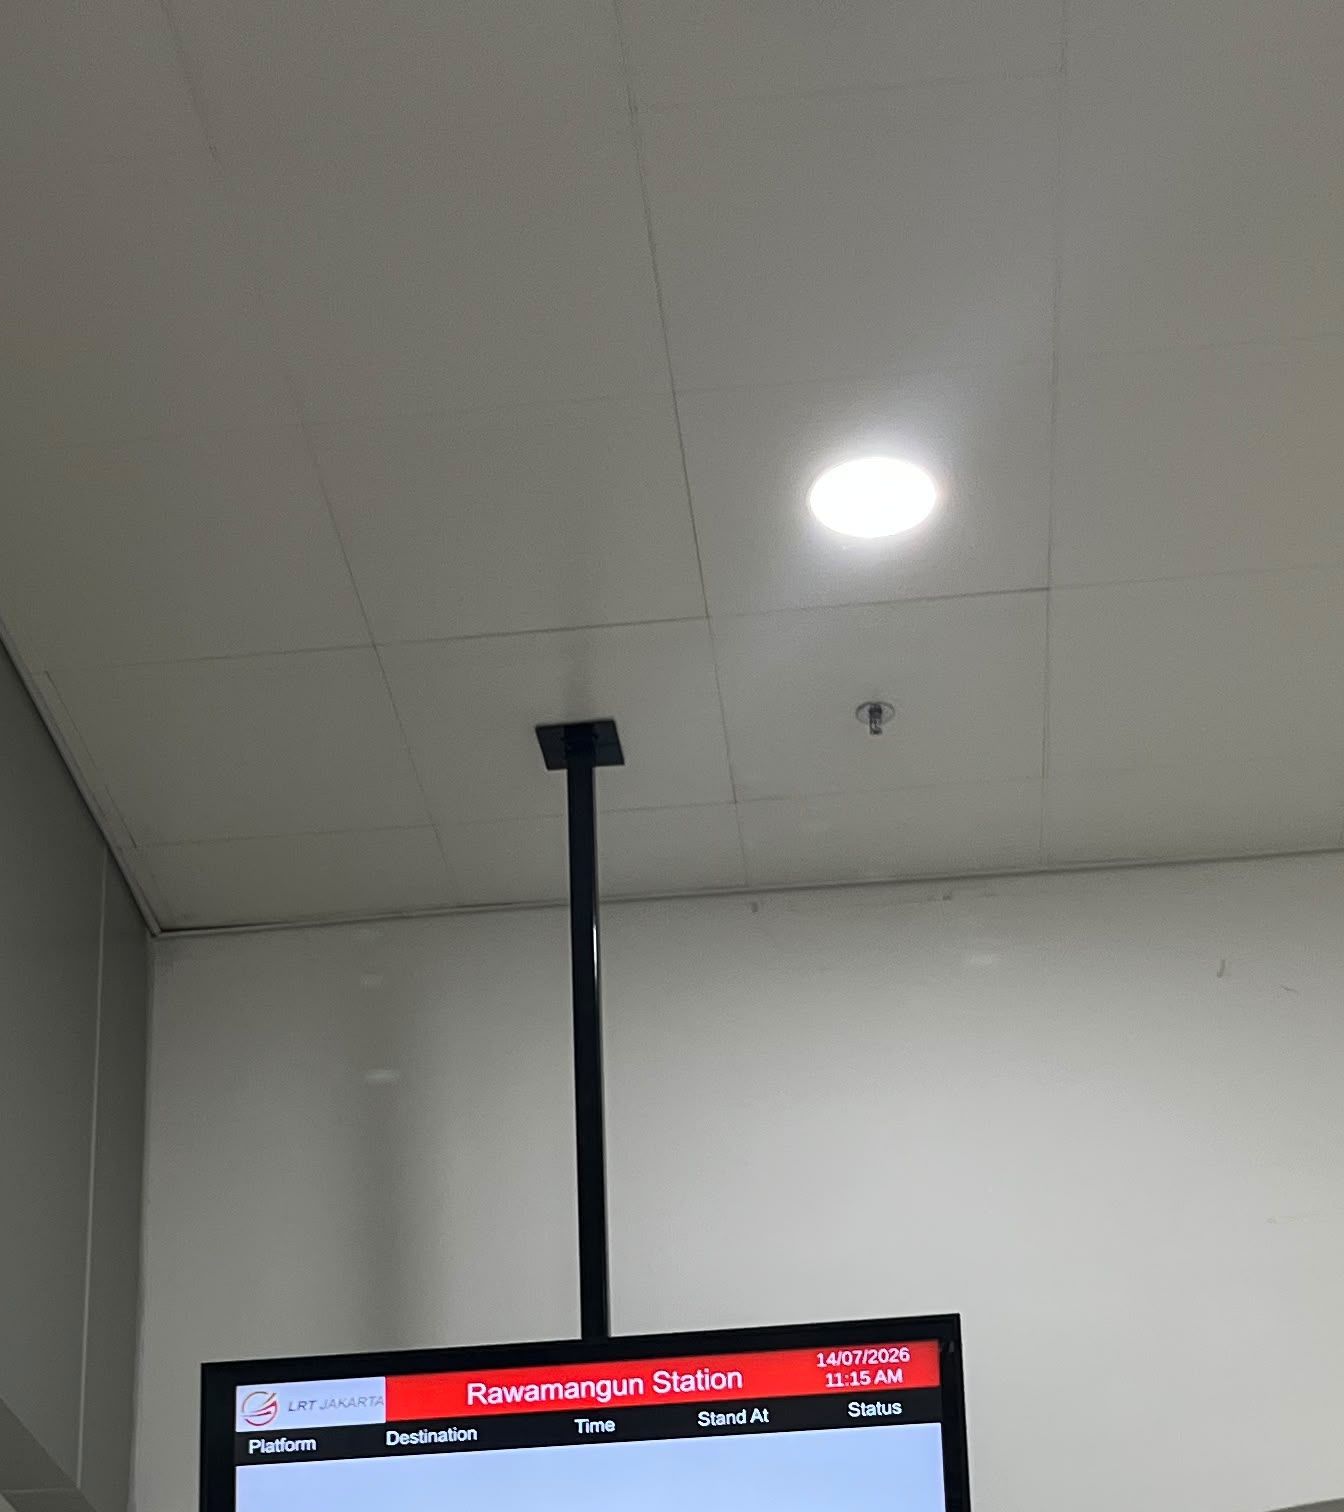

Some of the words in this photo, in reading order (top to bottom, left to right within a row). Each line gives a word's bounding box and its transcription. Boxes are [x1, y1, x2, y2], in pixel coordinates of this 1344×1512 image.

[816, 1347, 911, 1368] 14/07/2026
[466, 1376, 644, 1406] Rawamangun
[652, 1368, 744, 1394] Station
[825, 1371, 871, 1388] 11:15
[874, 1369, 903, 1385] AM
[287, 1400, 317, 1413] LRT
[319, 1396, 385, 1411] JAKARTA
[248, 1437, 317, 1454] Platform
[385, 1427, 478, 1446] Destination
[574, 1417, 616, 1434] Time
[697, 1409, 747, 1427] Stand
[750, 1408, 770, 1424] At
[847, 1401, 903, 1418] Status
